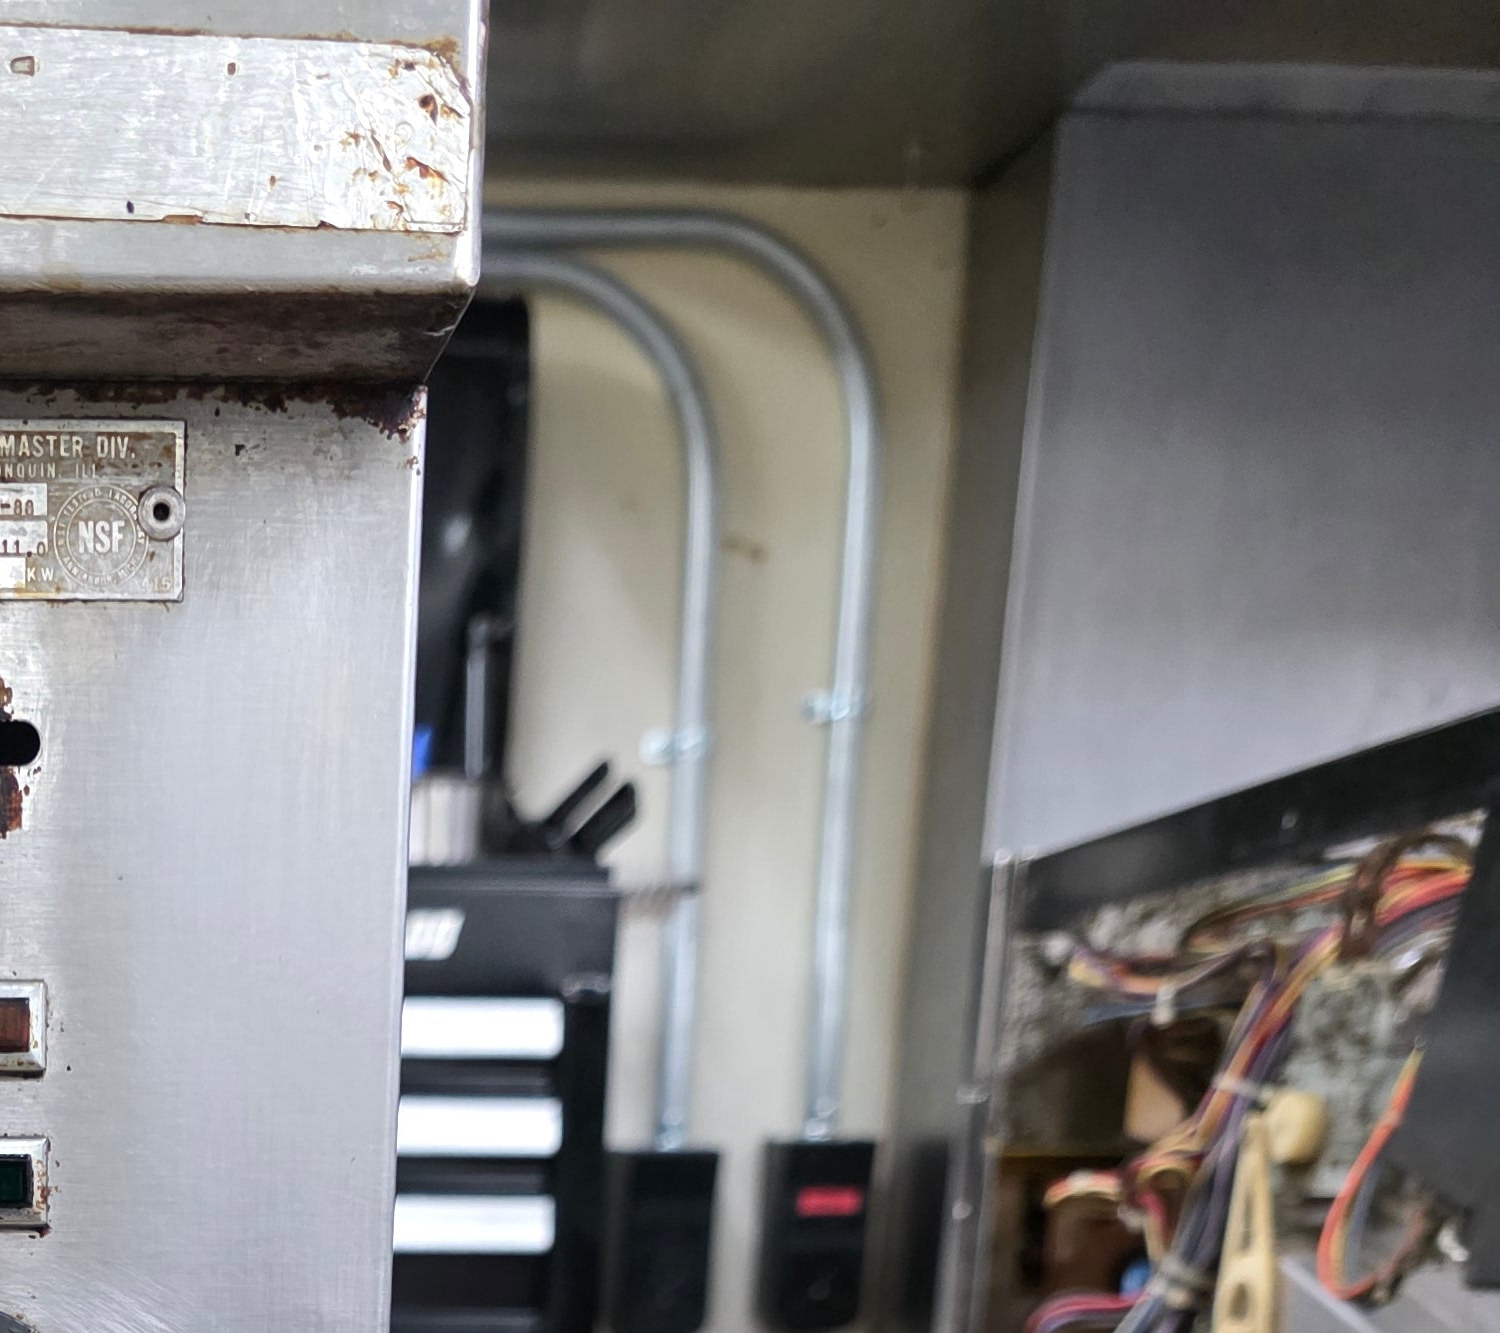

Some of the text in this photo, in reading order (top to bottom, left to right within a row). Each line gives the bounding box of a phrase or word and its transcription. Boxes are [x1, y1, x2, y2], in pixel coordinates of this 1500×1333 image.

[98, 436, 136, 459] DIV.
[78, 520, 125, 554] NSF
[1, 539, 47, 557] 11.0
[27, 567, 58, 582] K.W.
